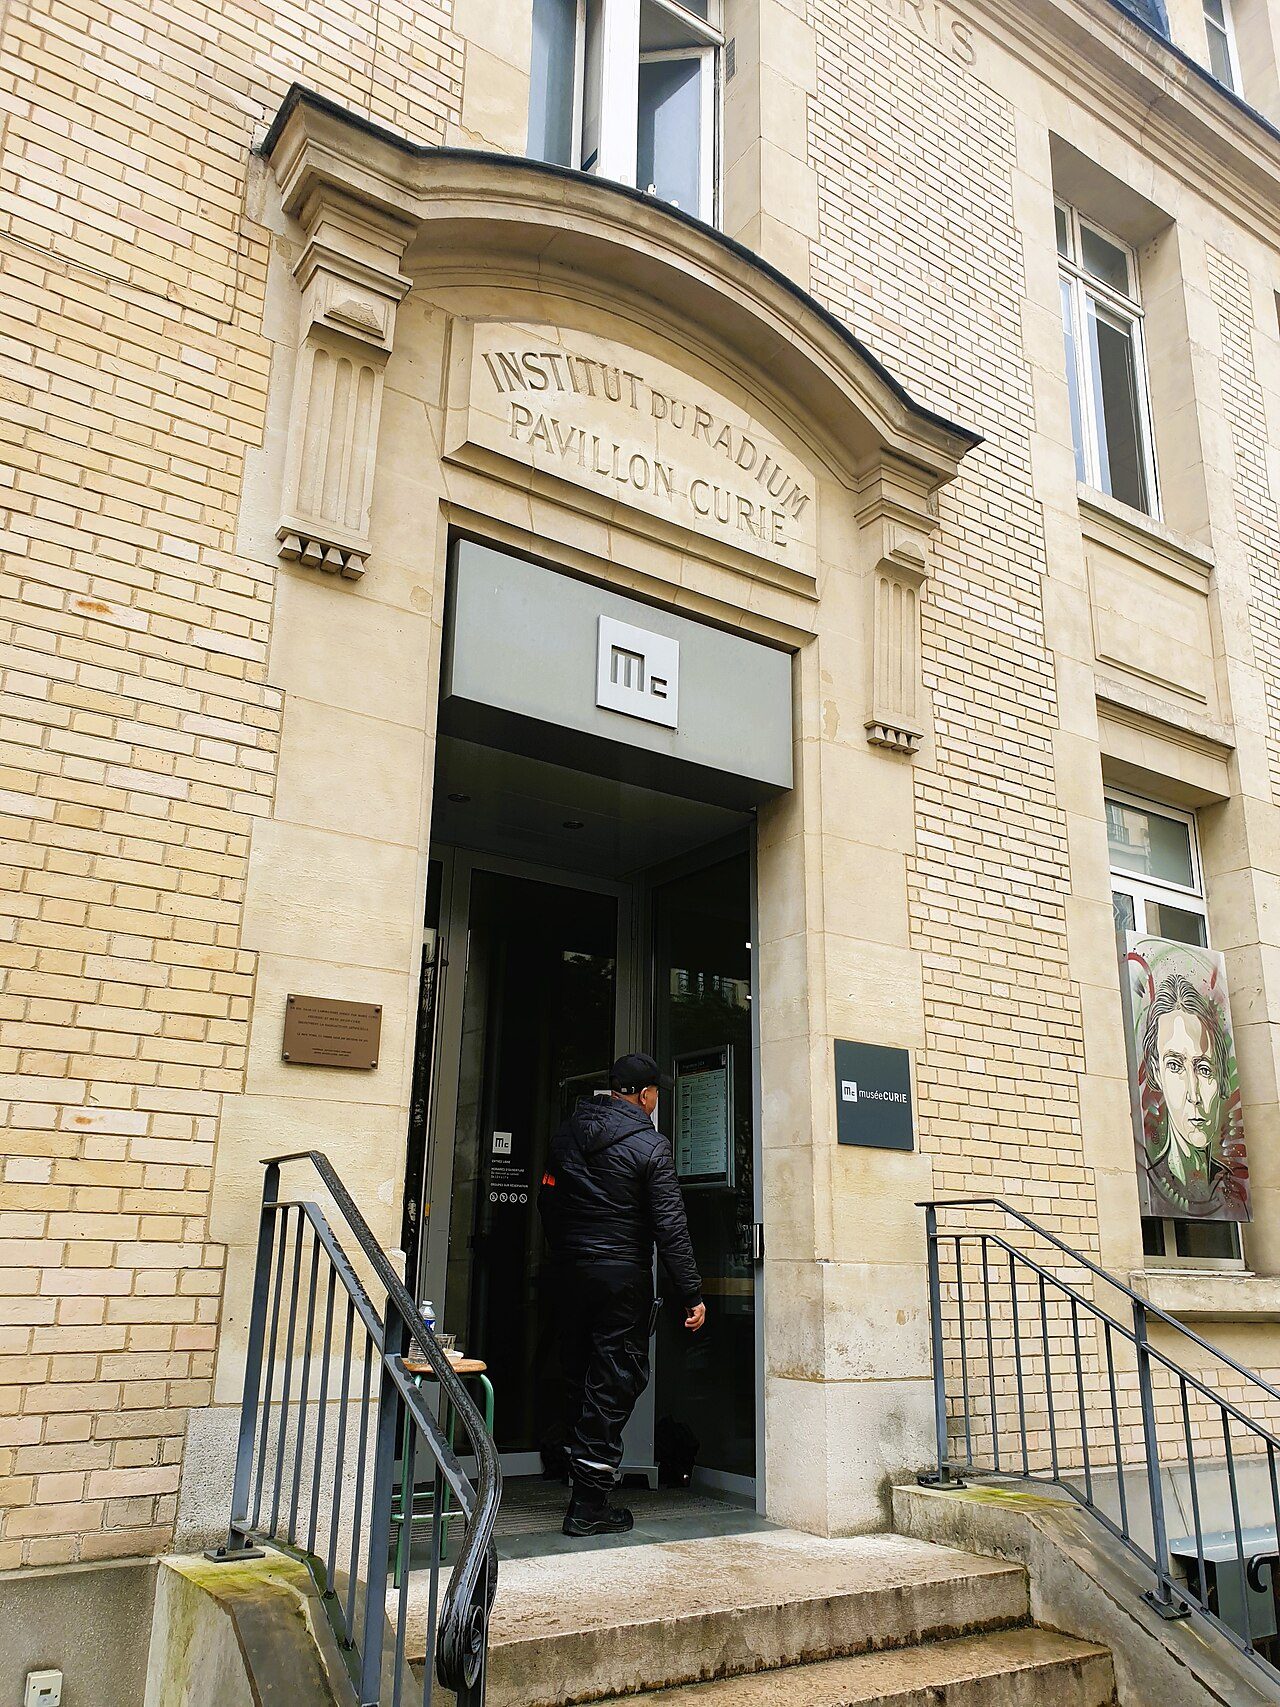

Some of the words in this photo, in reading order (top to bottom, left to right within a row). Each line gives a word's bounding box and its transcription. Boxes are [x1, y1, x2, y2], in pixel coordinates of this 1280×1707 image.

[481, 351, 644, 411] INSTITUT
[649, 388, 687, 430] DU
[690, 404, 812, 522] RADIUM
[508, 401, 675, 503] PAVILLON
[689, 478, 789, 549] CURIE
